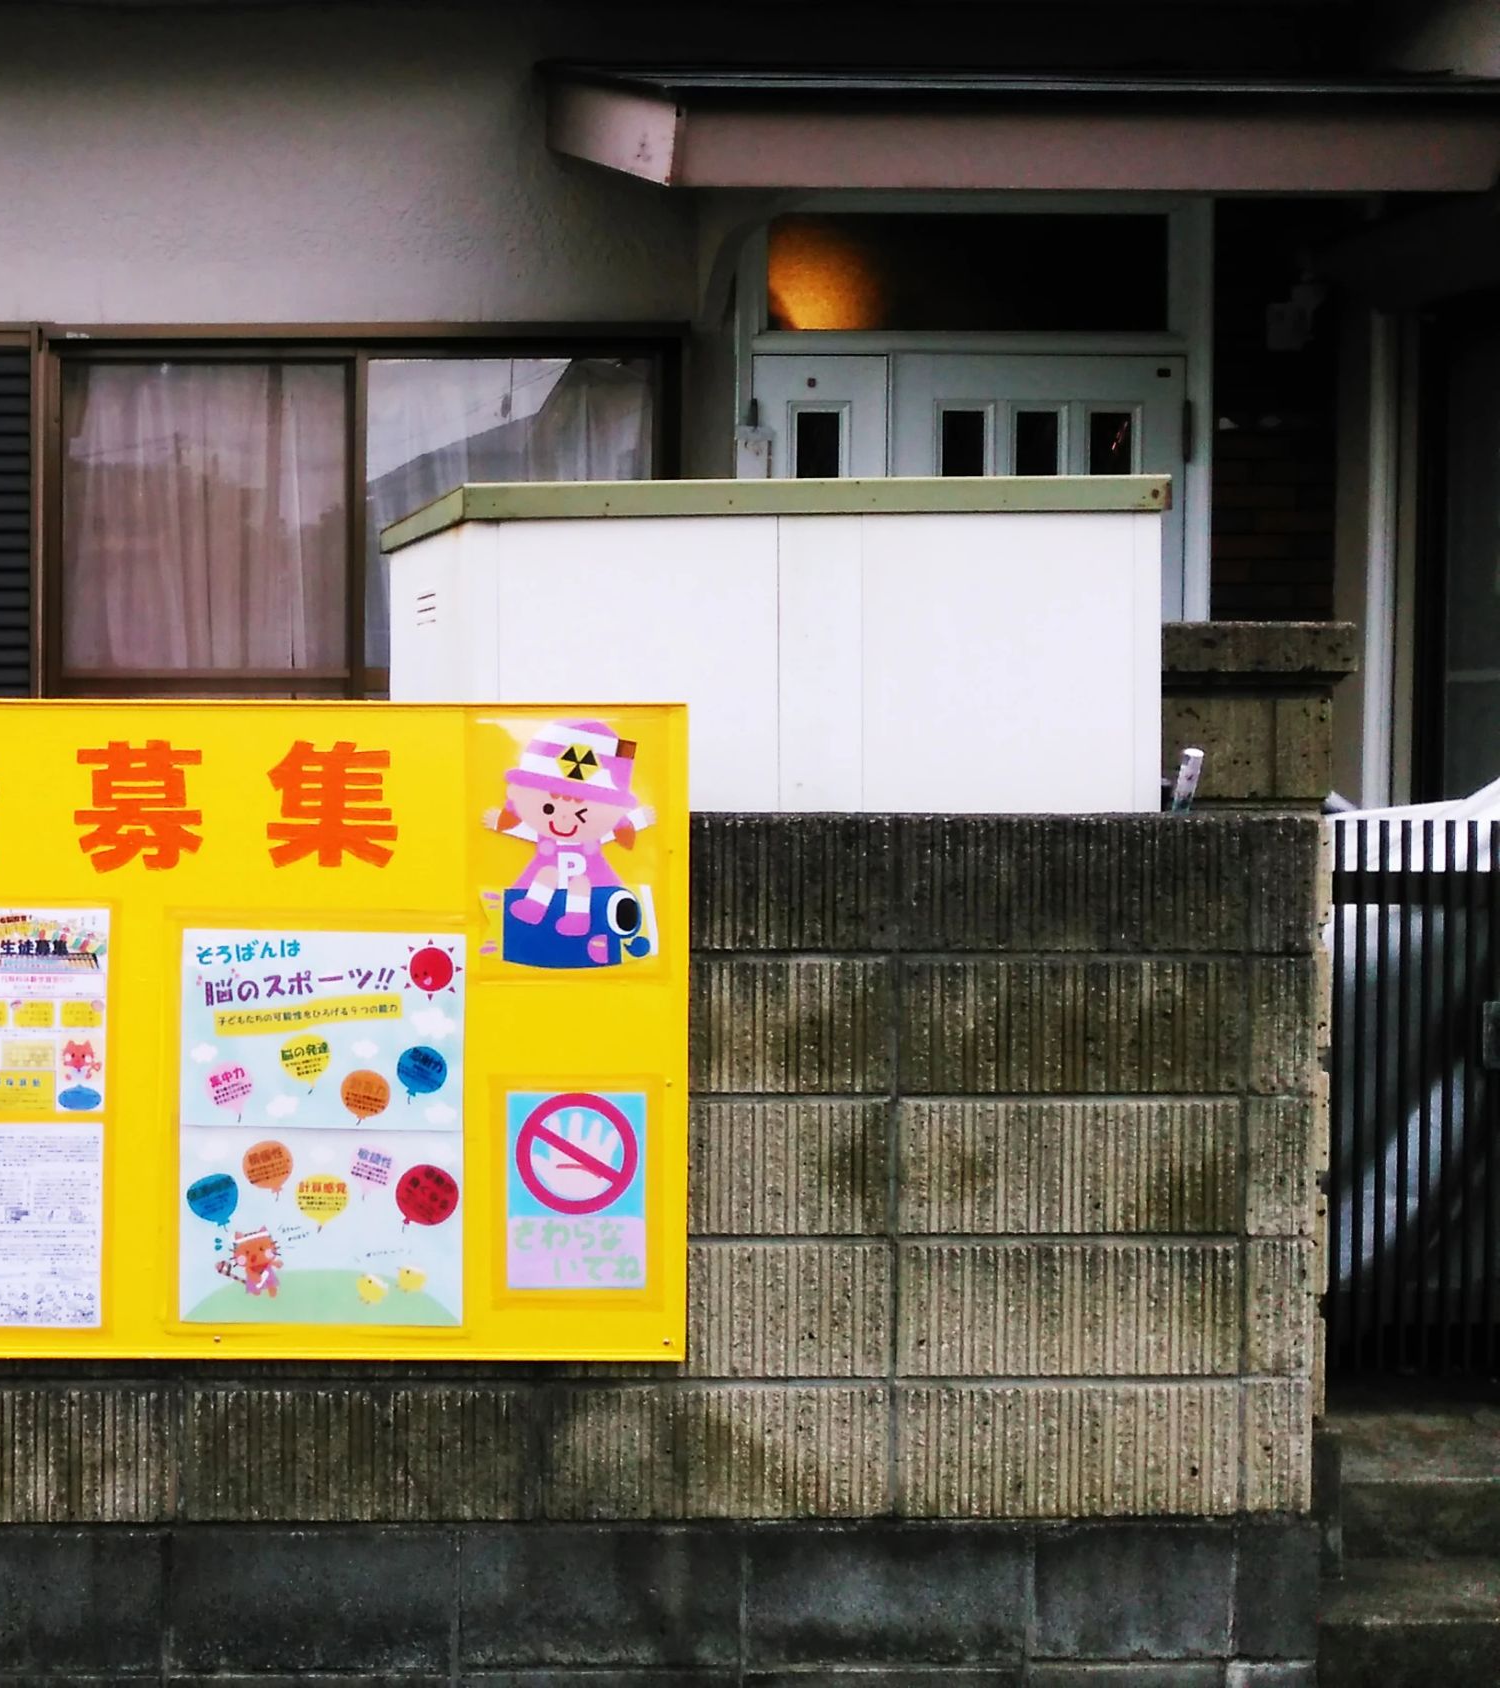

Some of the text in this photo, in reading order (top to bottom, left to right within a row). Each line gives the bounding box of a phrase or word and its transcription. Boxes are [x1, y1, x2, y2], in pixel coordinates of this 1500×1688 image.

[556, 845, 587, 888] P
[0, 939, 69, 957] 生徒募集
[195, 939, 302, 966] そろばんは
[281, 1041, 330, 1062] 脳の発達
[209, 1067, 246, 1088] 集中力
[512, 1218, 625, 1252] さわらな
[552, 1255, 642, 1281] いてね
